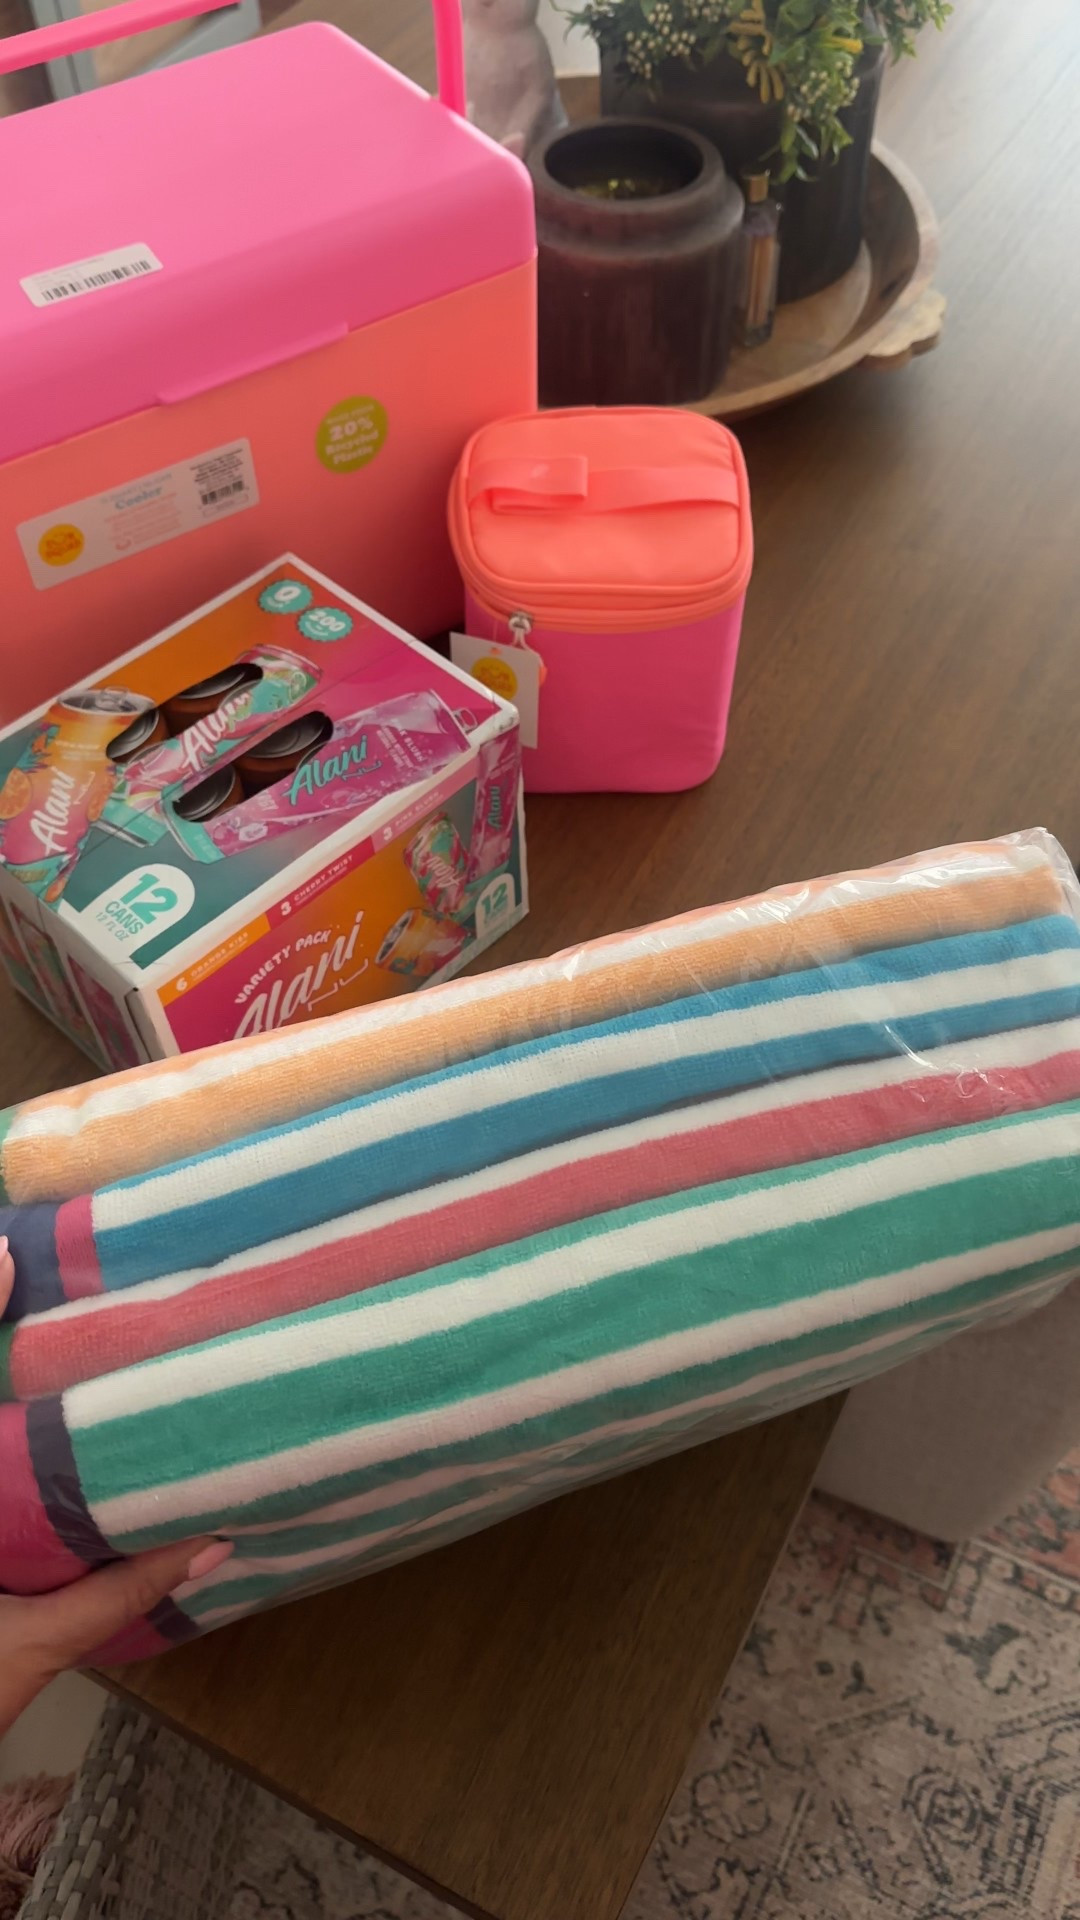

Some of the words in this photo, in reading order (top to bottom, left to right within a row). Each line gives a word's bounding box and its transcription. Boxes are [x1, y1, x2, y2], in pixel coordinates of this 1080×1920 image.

[274, 586, 301, 602] 0
[308, 610, 346, 632] 200
[281, 734, 368, 806] Alani
[30, 766, 76, 856] Alani
[382, 826, 393, 841] 3
[119, 873, 179, 925] 12
[281, 901, 292, 916] 3
[294, 874, 326, 902] CHERRY
[328, 855, 353, 876] TWIST
[105, 901, 144, 935] CANS
[114, 929, 130, 942] OZ
[176, 977, 188, 992] 6
[232, 910, 365, 1040] Alani
[234, 944, 291, 1004] VARIETY
[295, 929, 332, 952] PACK
